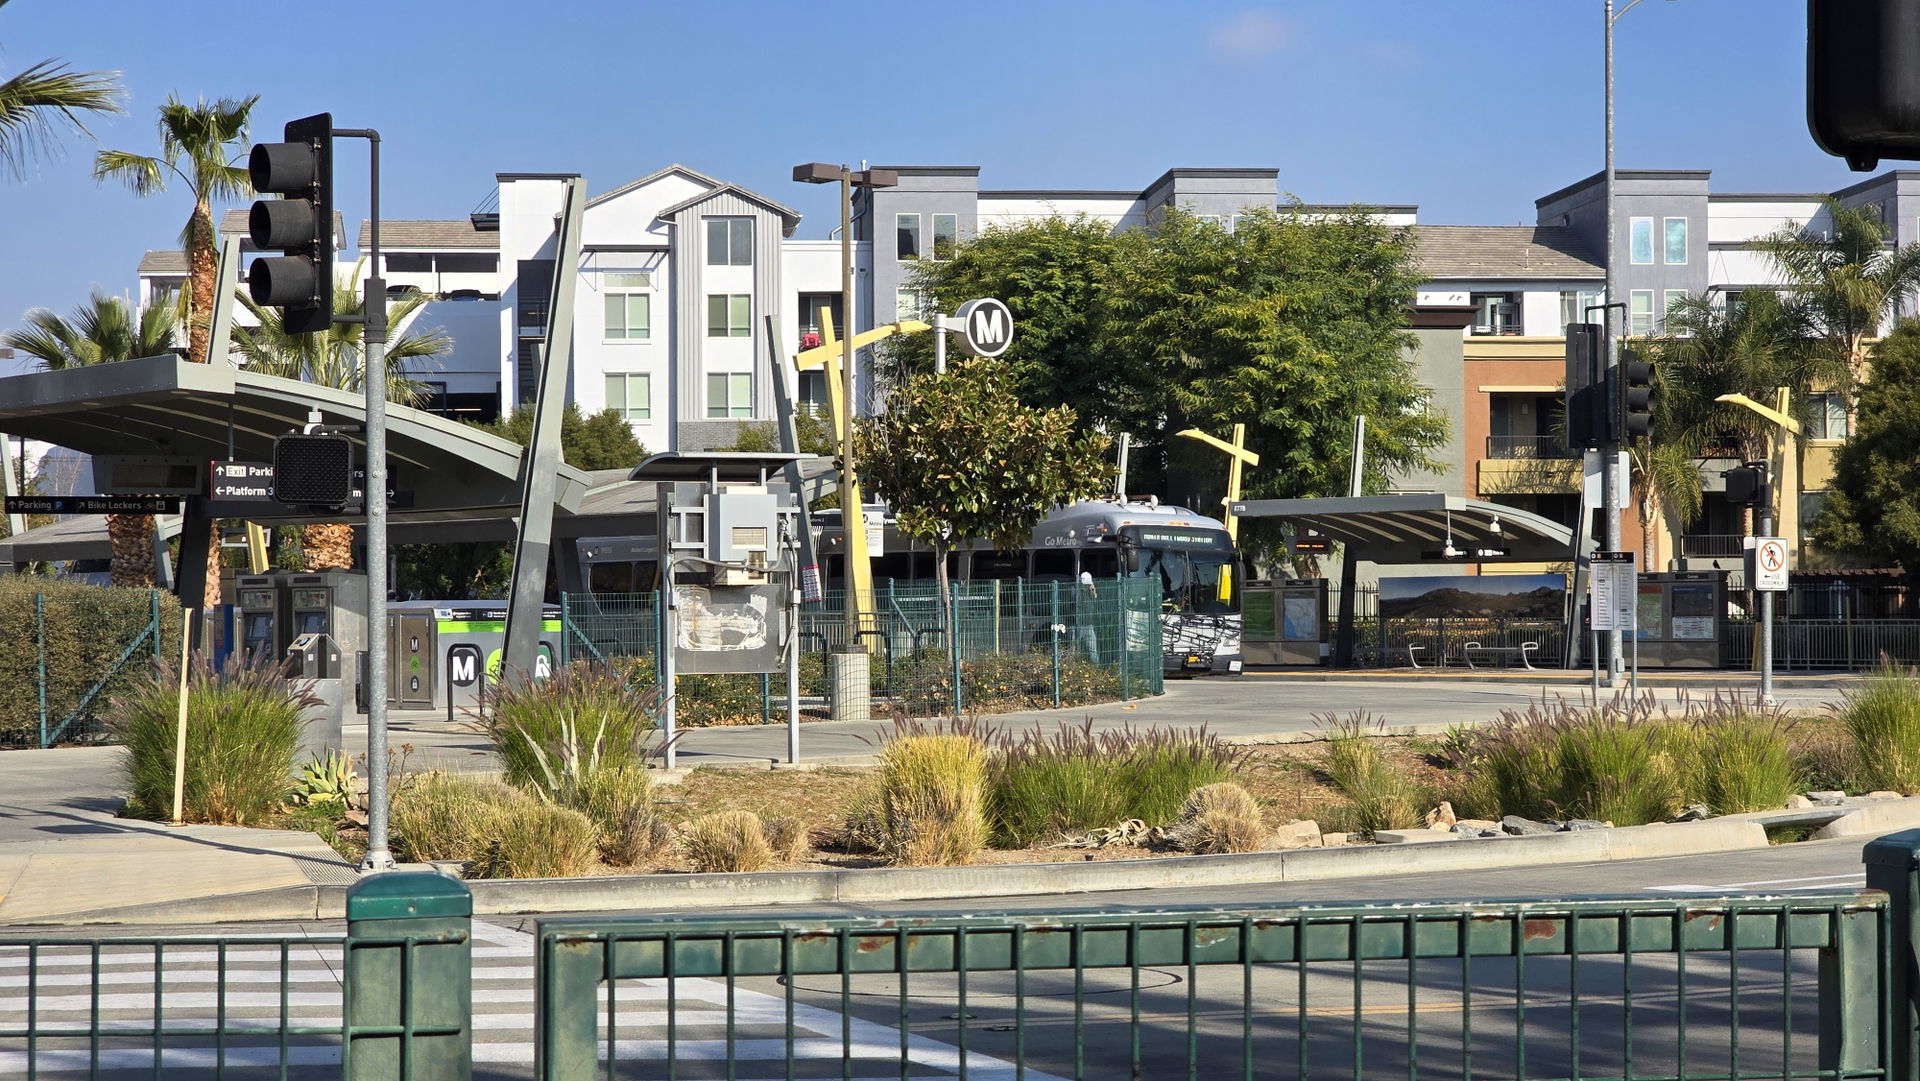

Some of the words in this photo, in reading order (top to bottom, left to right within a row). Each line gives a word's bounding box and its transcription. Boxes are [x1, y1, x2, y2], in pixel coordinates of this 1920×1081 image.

[975, 309, 1004, 345] M
[227, 467, 245, 477] Exit
[249, 467, 274, 476] Parki
[226, 487, 266, 496] Platform
[18, 501, 52, 510] Parking
[88, 501, 107, 509] Bike
[109, 501, 142, 510] Lockers
[1045, 537, 1056, 547] Go
[1056, 536, 1077, 547] Metro
[452, 656, 475, 681] M
